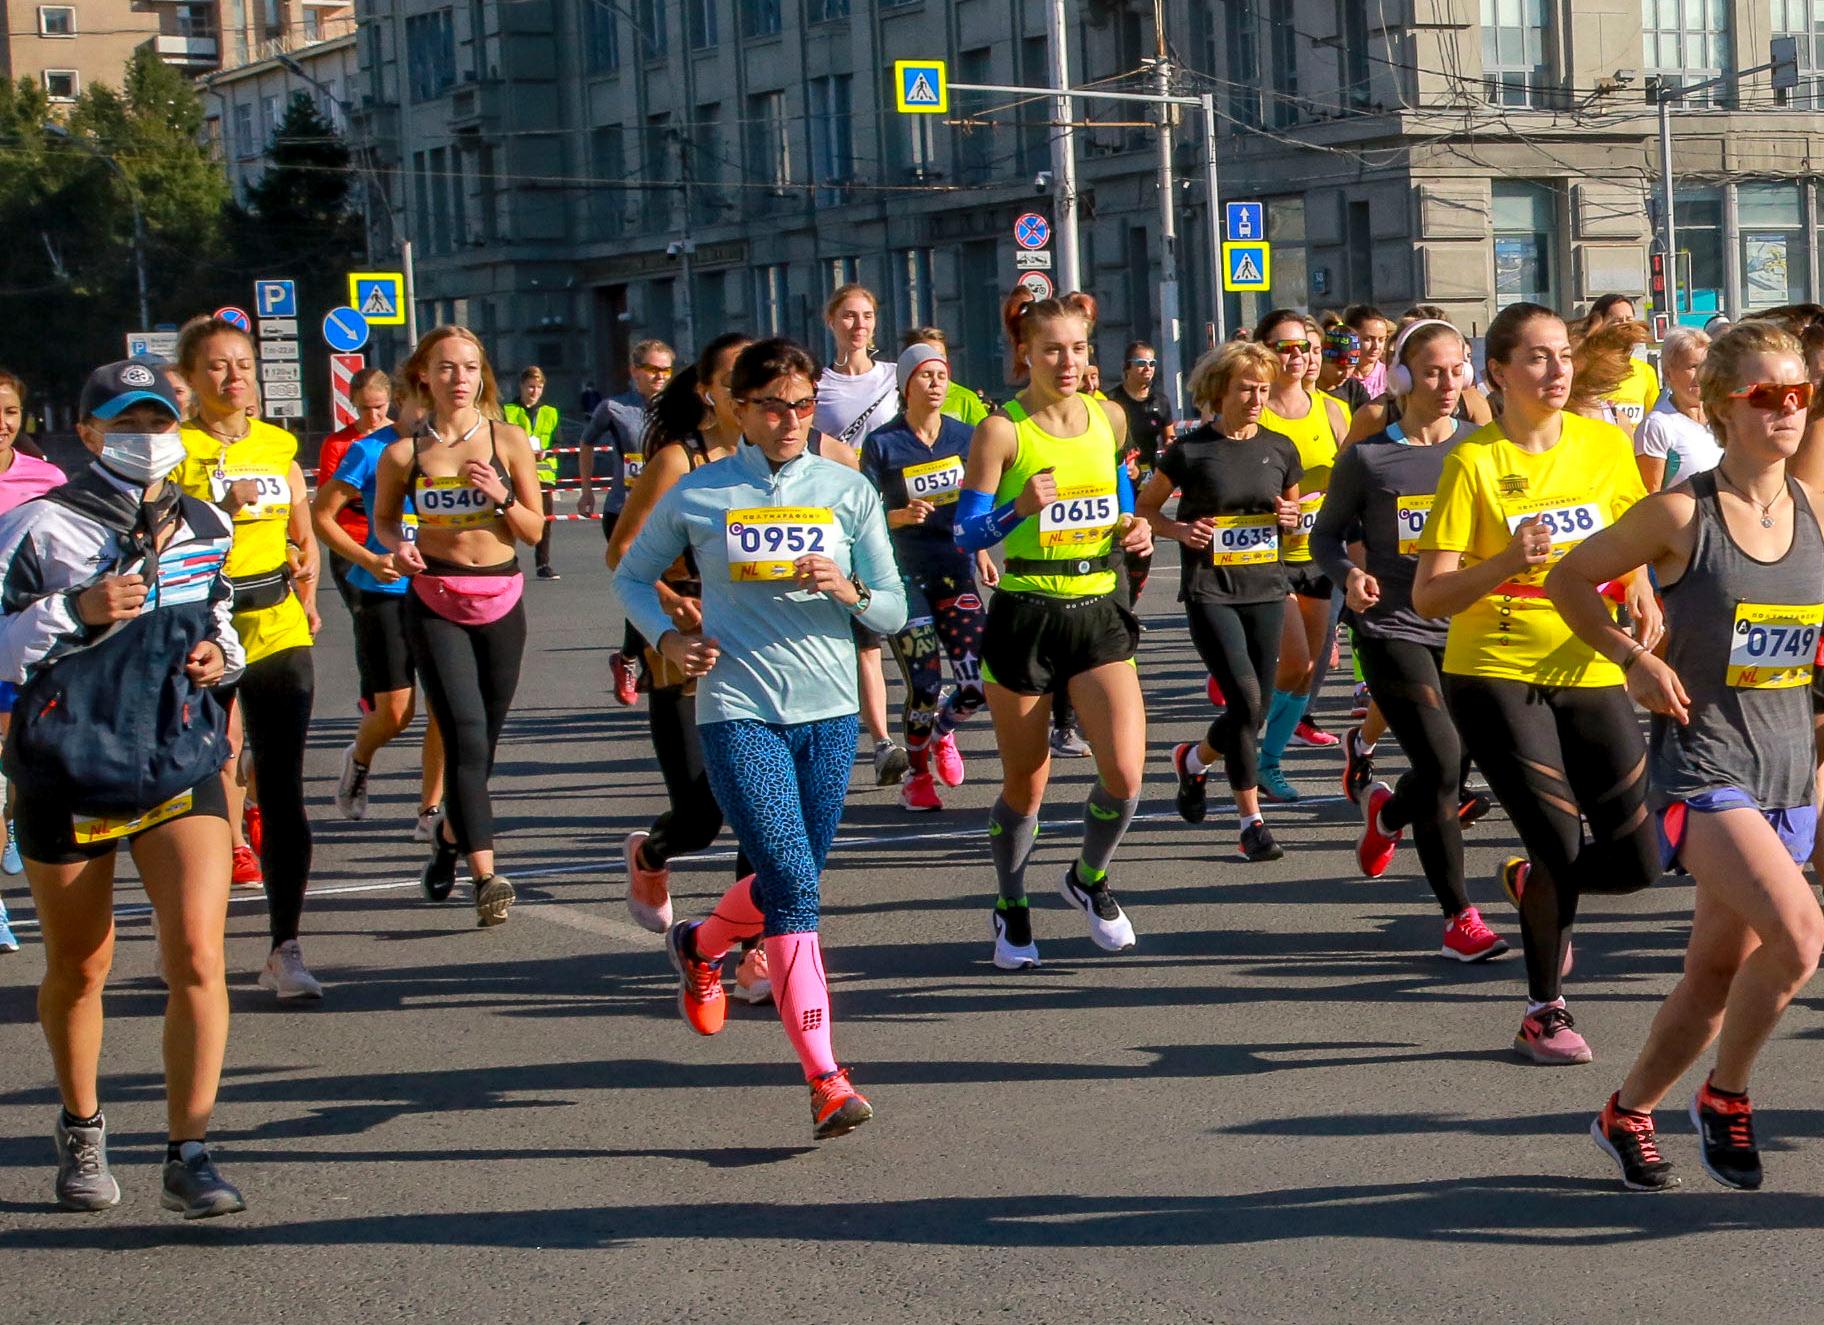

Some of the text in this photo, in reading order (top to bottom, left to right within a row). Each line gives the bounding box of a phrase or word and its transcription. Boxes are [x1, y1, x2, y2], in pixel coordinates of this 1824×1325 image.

[264, 284, 287, 313] P
[914, 469, 958, 492] 0537
[424, 489, 487, 509] 0540
[1051, 498, 1110, 524] 0615
[740, 527, 825, 553] 0952
[1222, 527, 1272, 547] 0635
[1737, 620, 1749, 633] A
[1747, 628, 1815, 657] 0749
[802, 1023, 821, 1032] cep
